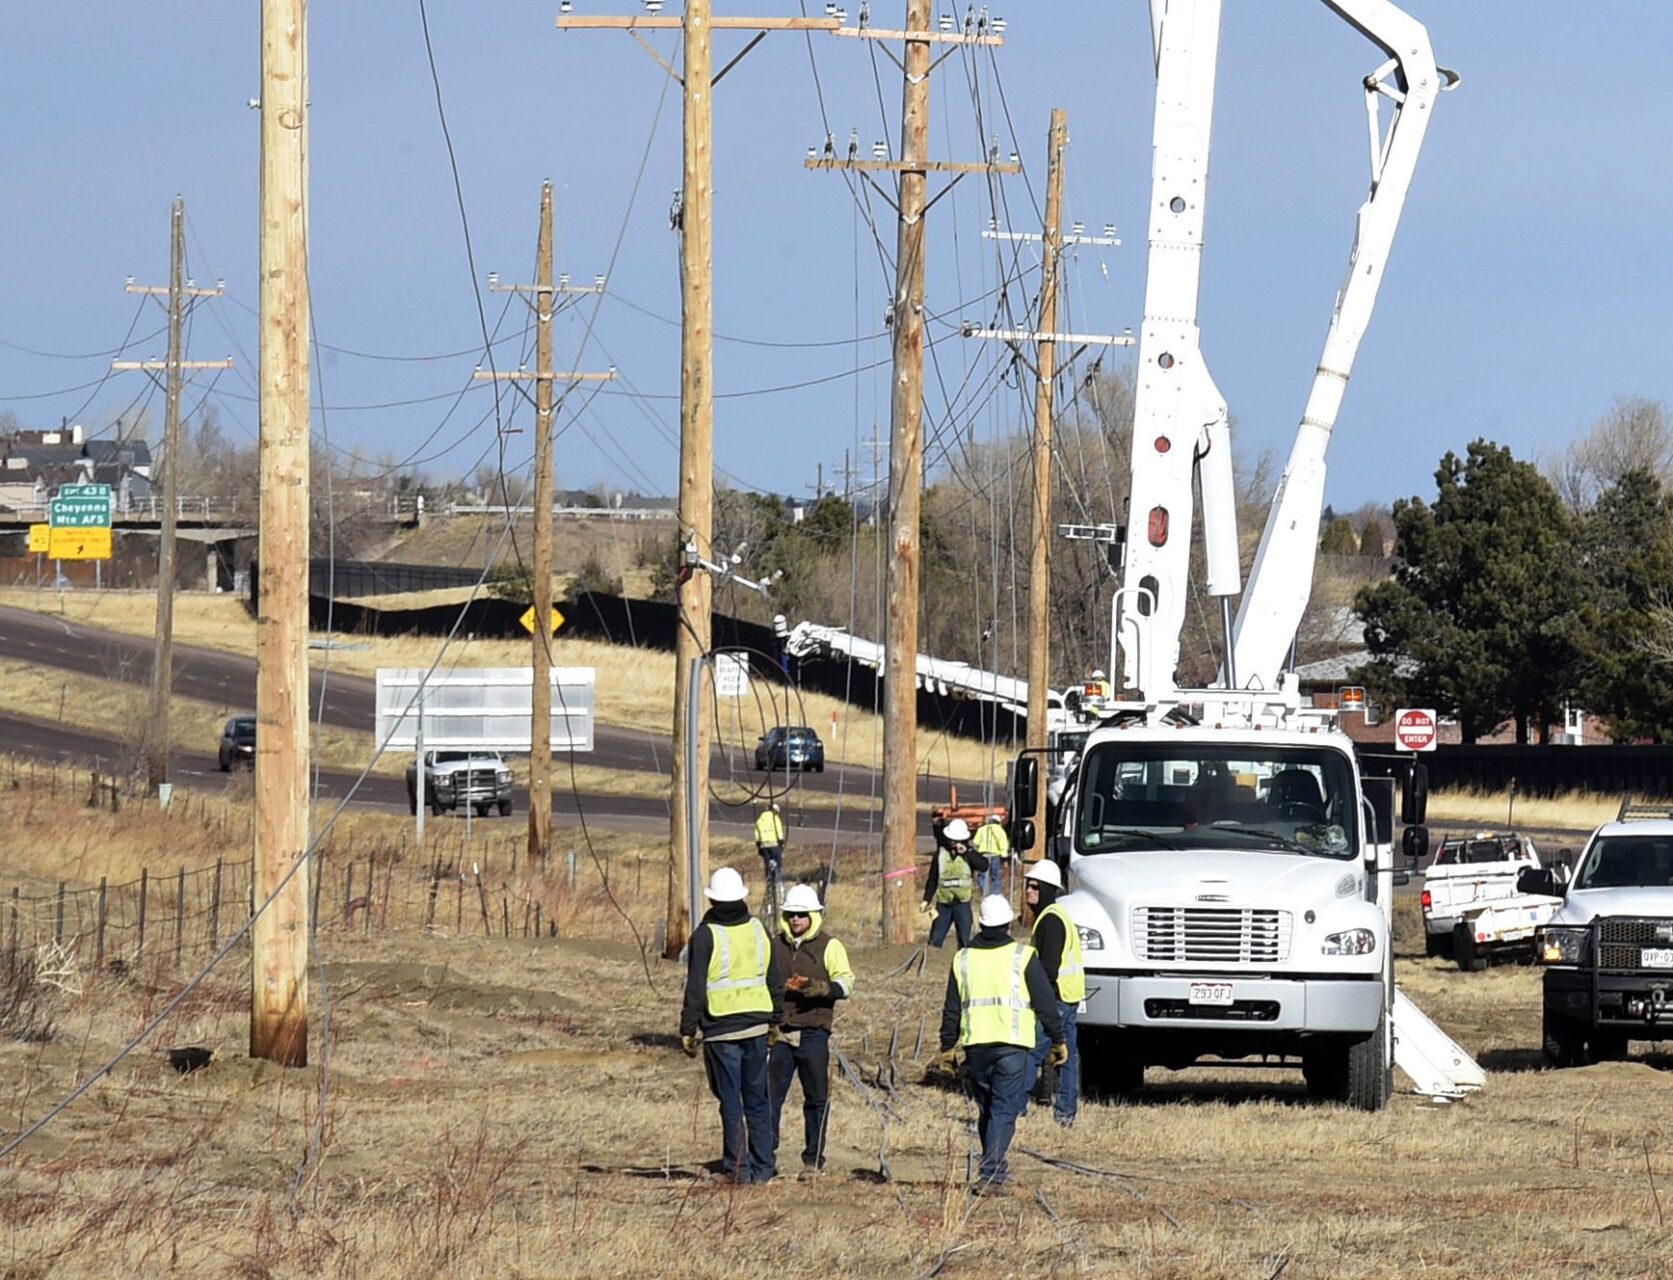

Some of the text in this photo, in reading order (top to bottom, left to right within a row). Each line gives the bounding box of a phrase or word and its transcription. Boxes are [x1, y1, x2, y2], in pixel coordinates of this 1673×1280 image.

[54, 503, 107, 514] Cheyenne
[57, 515, 104, 524] Mtn AFS
[1415, 717, 1429, 725] NOT
